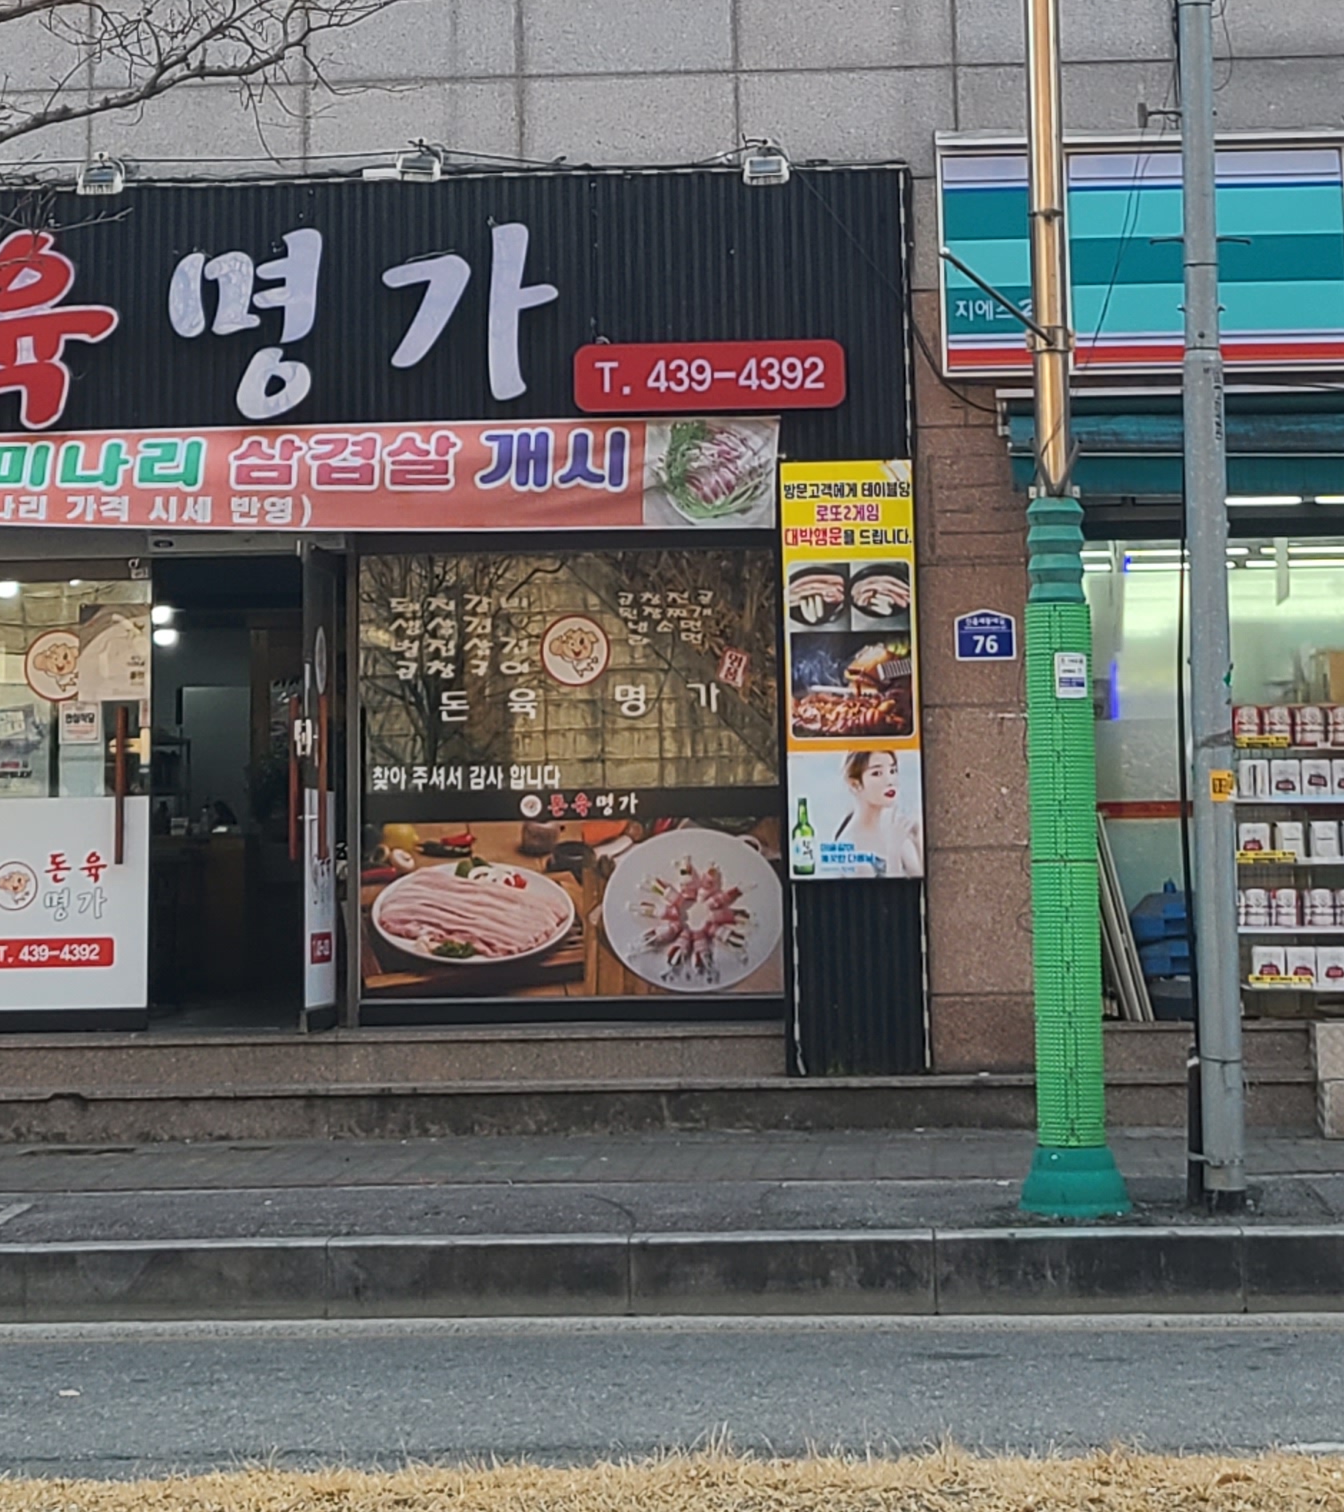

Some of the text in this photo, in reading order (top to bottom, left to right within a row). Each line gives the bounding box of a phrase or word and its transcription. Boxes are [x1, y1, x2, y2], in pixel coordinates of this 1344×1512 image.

[955, 297, 1033, 322] 지에스2
[595, 355, 825, 394] T. 439-4392
[231, 432, 456, 488] 삼겹살
[480, 425, 630, 491] 개시
[67, 494, 129, 521] 가격
[149, 496, 212, 522] 시세
[231, 494, 312, 527] 반영)
[973, 635, 998, 653] 76
[372, 764, 560, 791] 찾아 주셔서 감사 합니다
[19, 943, 99, 962] 439-4392
